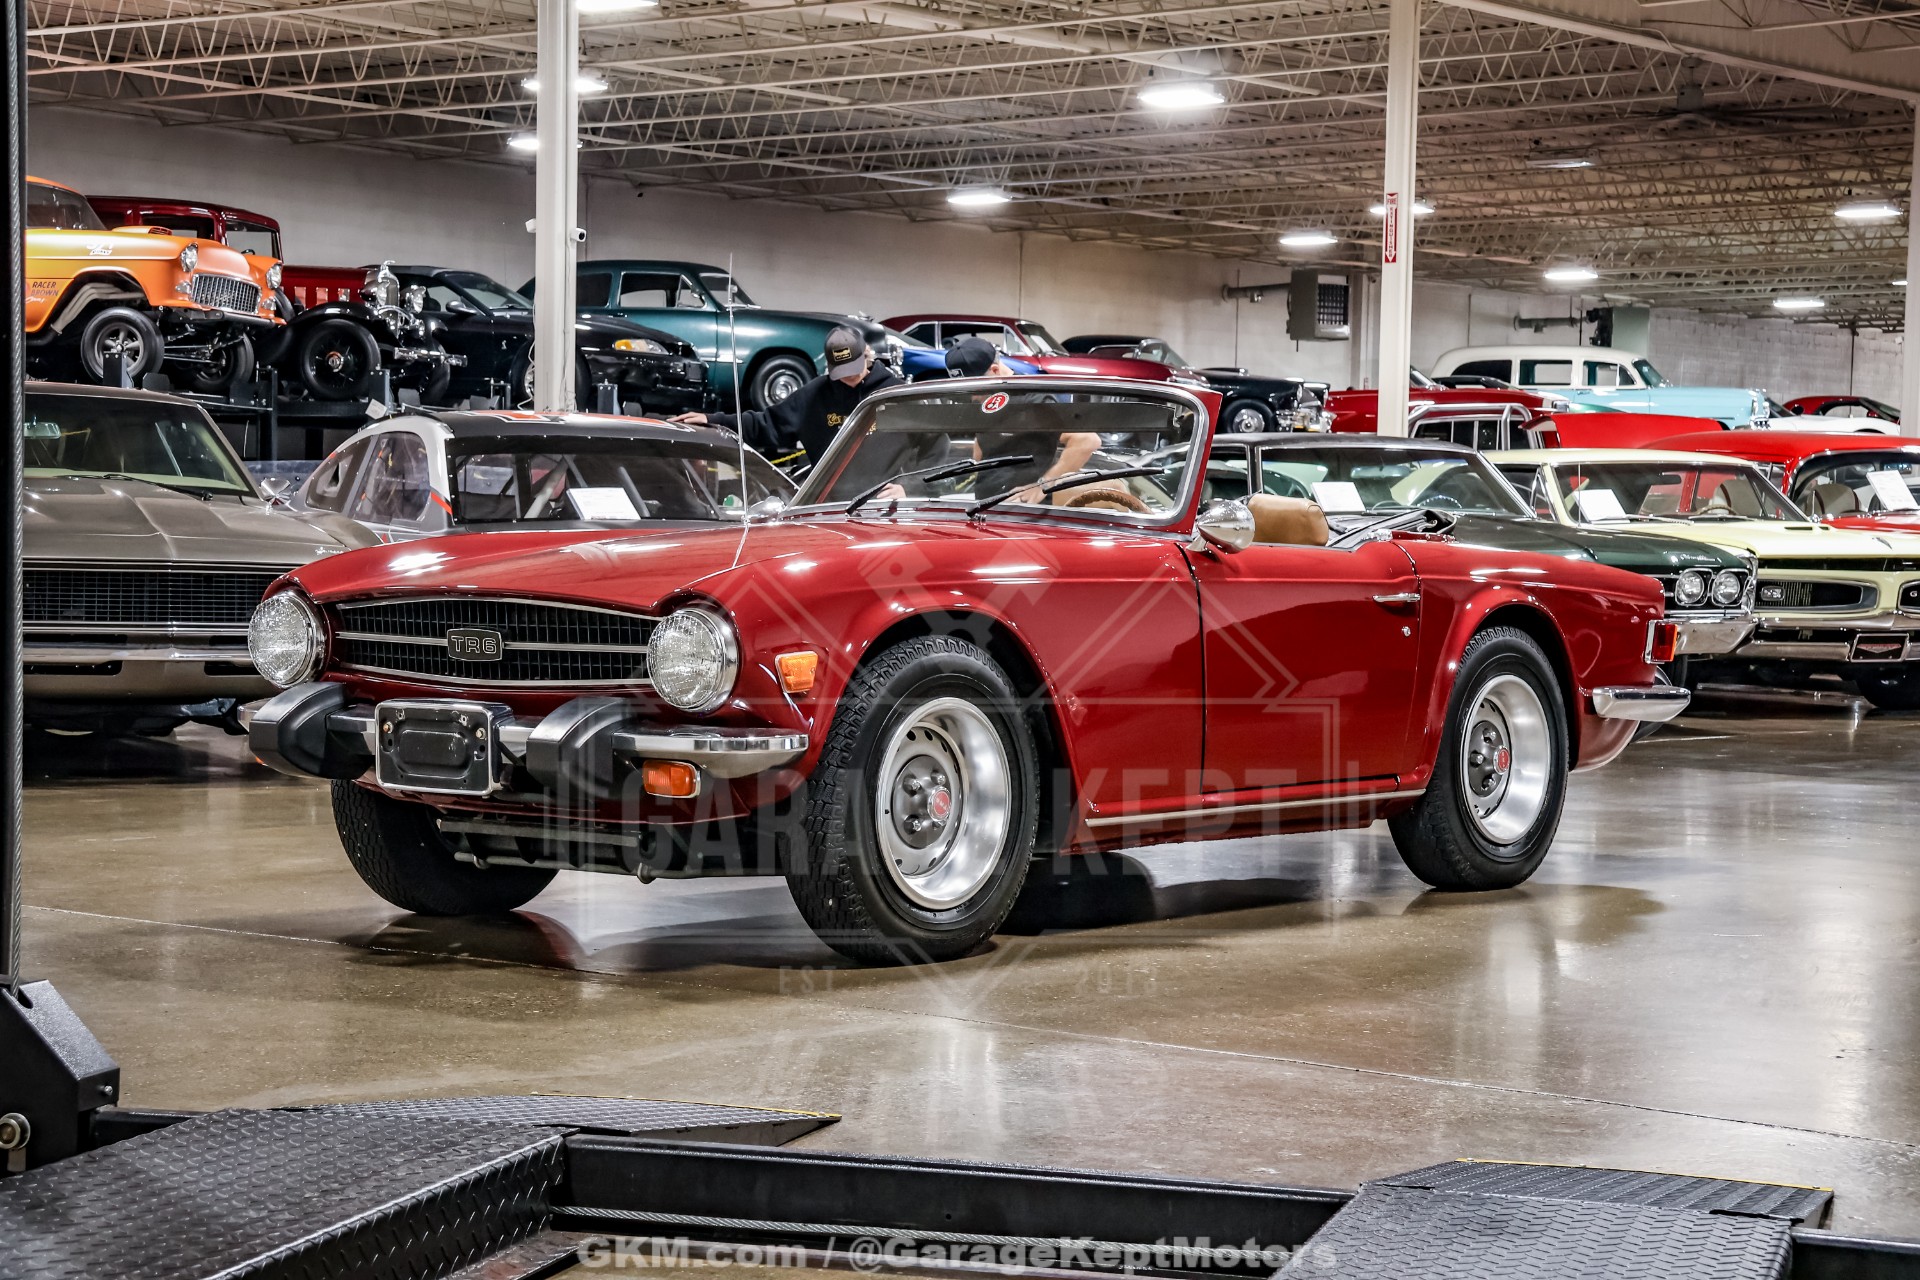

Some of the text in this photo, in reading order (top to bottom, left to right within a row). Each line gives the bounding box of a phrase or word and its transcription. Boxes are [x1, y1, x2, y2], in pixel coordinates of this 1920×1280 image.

[32, 281, 57, 289] RACER
[30, 289, 59, 297] BROWN
[450, 635, 497, 654] TR6
